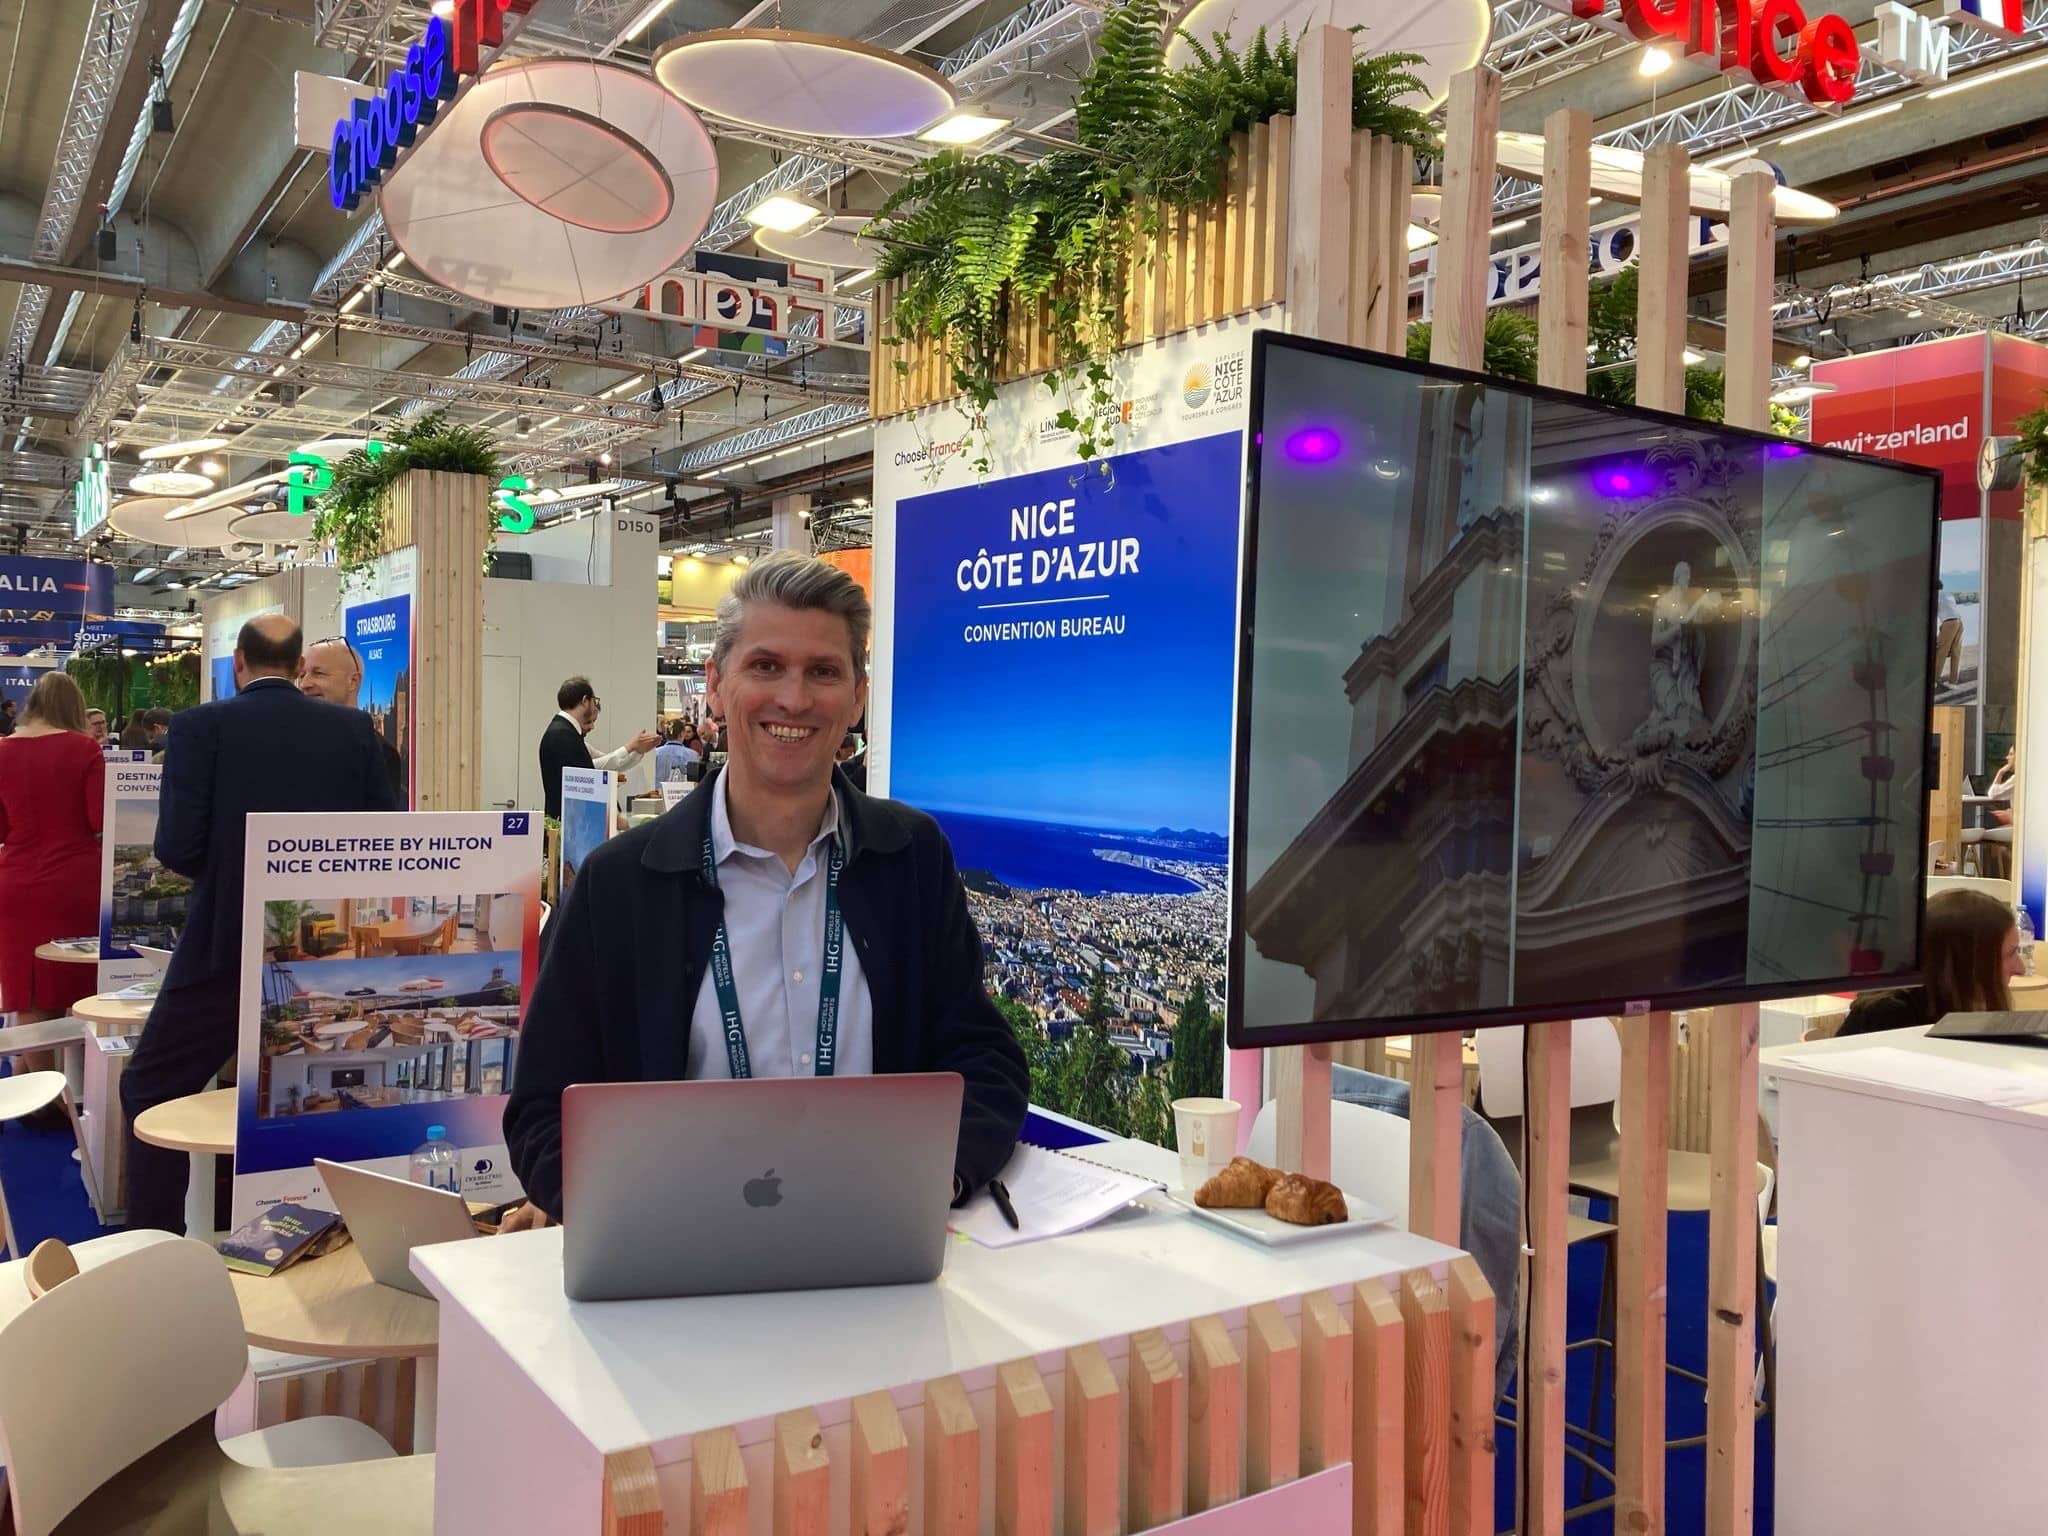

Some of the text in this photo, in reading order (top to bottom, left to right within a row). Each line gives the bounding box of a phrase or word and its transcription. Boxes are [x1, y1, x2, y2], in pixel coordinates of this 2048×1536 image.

[329, 15, 459, 211] Choose
[1215, 358, 1243, 377] NICE
[895, 440, 962, 466] Choose France
[618, 519, 654, 533] D150
[1011, 498, 1076, 542] NICE
[956, 548, 1024, 592] CÔTE
[74, 632, 112, 642] SOUT
[356, 613, 396, 637] STRASBOURG
[964, 615, 1126, 643] CONVENTION BUREAU
[507, 818, 524, 829] 27
[267, 836, 492, 853] DOUBLETREE BY HILTON
[267, 856, 461, 874] NICE CENTRE ICONIC
[830, 860, 844, 887] IHG
[714, 954, 724, 988] RESORTS
[721, 953, 729, 980] HOTELS
[826, 942, 840, 973] IHG
[725, 1010, 742, 1042] IHG
[821, 1002, 829, 1032] HOTELS
[827, 997, 836, 1033] RESORTS
[819, 1033, 833, 1066] IHG
[255, 1199, 282, 1207] Choose
